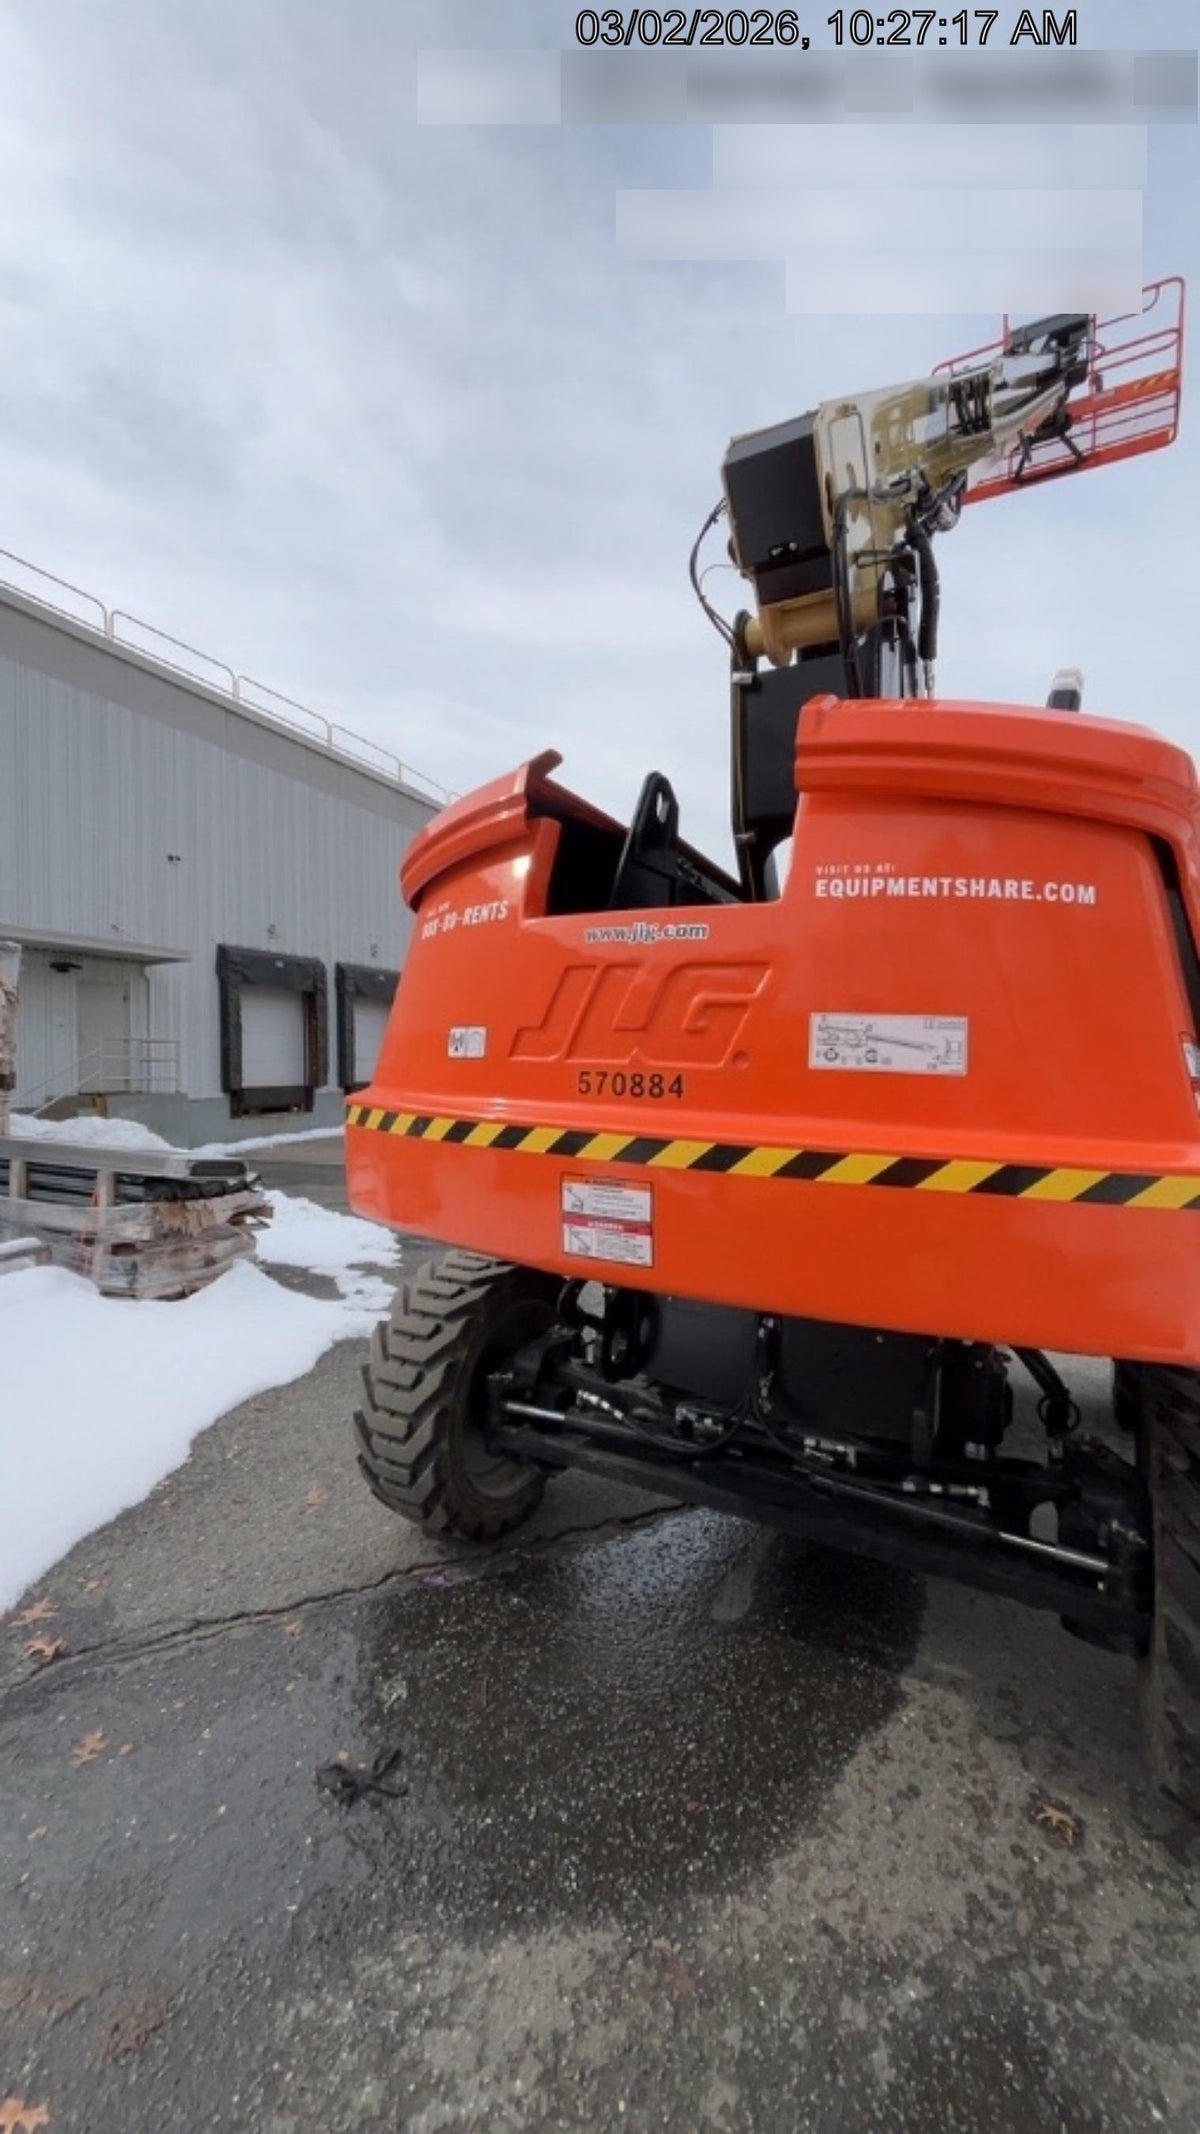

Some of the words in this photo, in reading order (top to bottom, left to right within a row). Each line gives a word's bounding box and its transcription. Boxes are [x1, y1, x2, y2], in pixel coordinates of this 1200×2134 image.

[816, 864, 849, 875] VISIT
[815, 877, 1096, 905] EQUIPMENTSHARE.COM
[585, 922, 709, 944] www.jlg.com
[508, 963, 772, 1069] JLG
[578, 1071, 684, 1099] 570884
